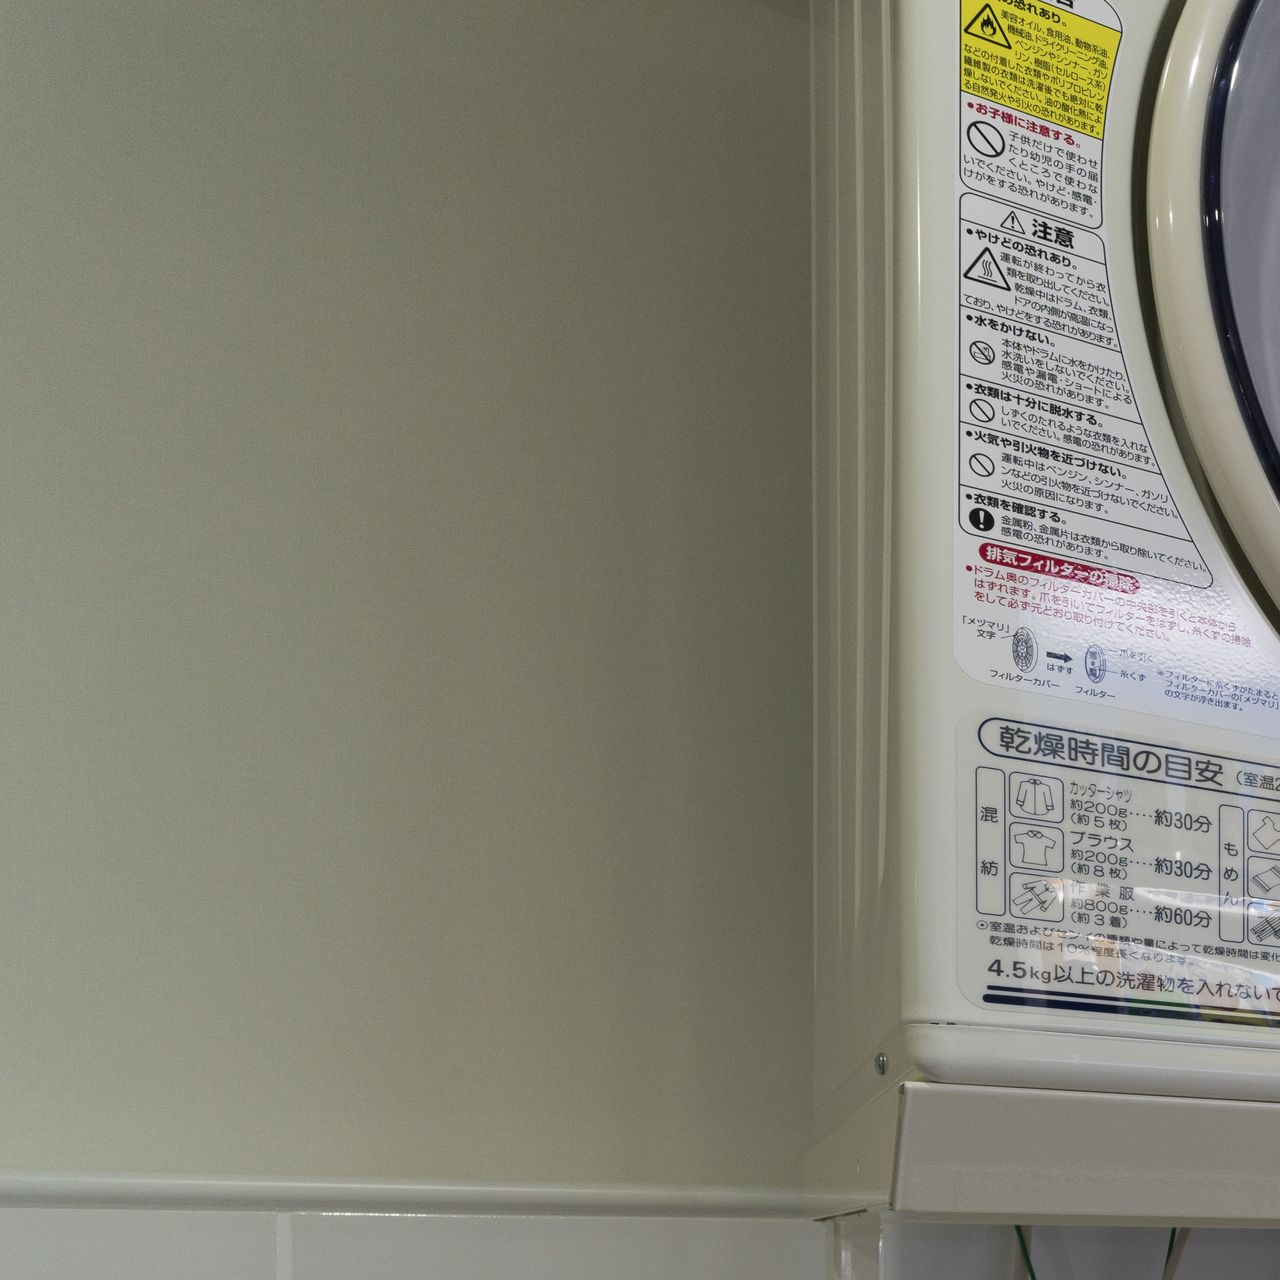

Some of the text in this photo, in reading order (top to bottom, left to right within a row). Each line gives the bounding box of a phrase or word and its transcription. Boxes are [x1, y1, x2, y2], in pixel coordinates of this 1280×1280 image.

[975, 102, 1081, 149] お子様に注意する。
[1007, 145, 1099, 182] たり幼児の手の届
[1008, 131, 1098, 167] 子供だけで使わせ
[963, 167, 1095, 219] けがをする恐れがあります。
[1009, 157, 1098, 194] くところで使わな
[975, 228, 1078, 270] やけどの恐れあり。
[1031, 218, 1075, 249] 注意
[1000, 251, 1106, 293] 運転が終わってから衣
[1006, 266, 1110, 307] 類を取り出してください。
[963, 293, 1118, 348] ており、やけどをする恐れがあります。
[975, 315, 1056, 347] 水をかけない。
[1014, 295, 1115, 333] ドアの内側が高温になっ
[1001, 338, 1127, 383] 本体やドラムに水をかけたり、
[1001, 350, 1131, 394] 水洗いをしないでください。
[974, 383, 1105, 428] 衣類は十分に脱水する。
[1001, 371, 1110, 410] 火災の恐れがあります。
[1001, 406, 1149, 454] しずくのたれるような衣類を入れな
[1001, 417, 1156, 467] いでください。感電の恐れがあります。
[974, 430, 1128, 480] 火気や引火物を近づけない。
[974, 493, 1067, 525] 衣類を確認する。
[1001, 478, 1109, 514] 火災の原因になります。
[1001, 527, 1109, 560] 感電の恐れがあります。
[976, 629, 996, 640] 文字
[989, 669, 1060, 689] フィルターカバー
[1047, 663, 1073, 675] はずす
[1119, 669, 1147, 681] 糸くず
[1075, 685, 1116, 700] フィルター
[1000, 726, 1223, 786] 乾燥時間の目安
[1070, 780, 1133, 803] カッターシャツ
[1070, 831, 1135, 853] ブラウス
